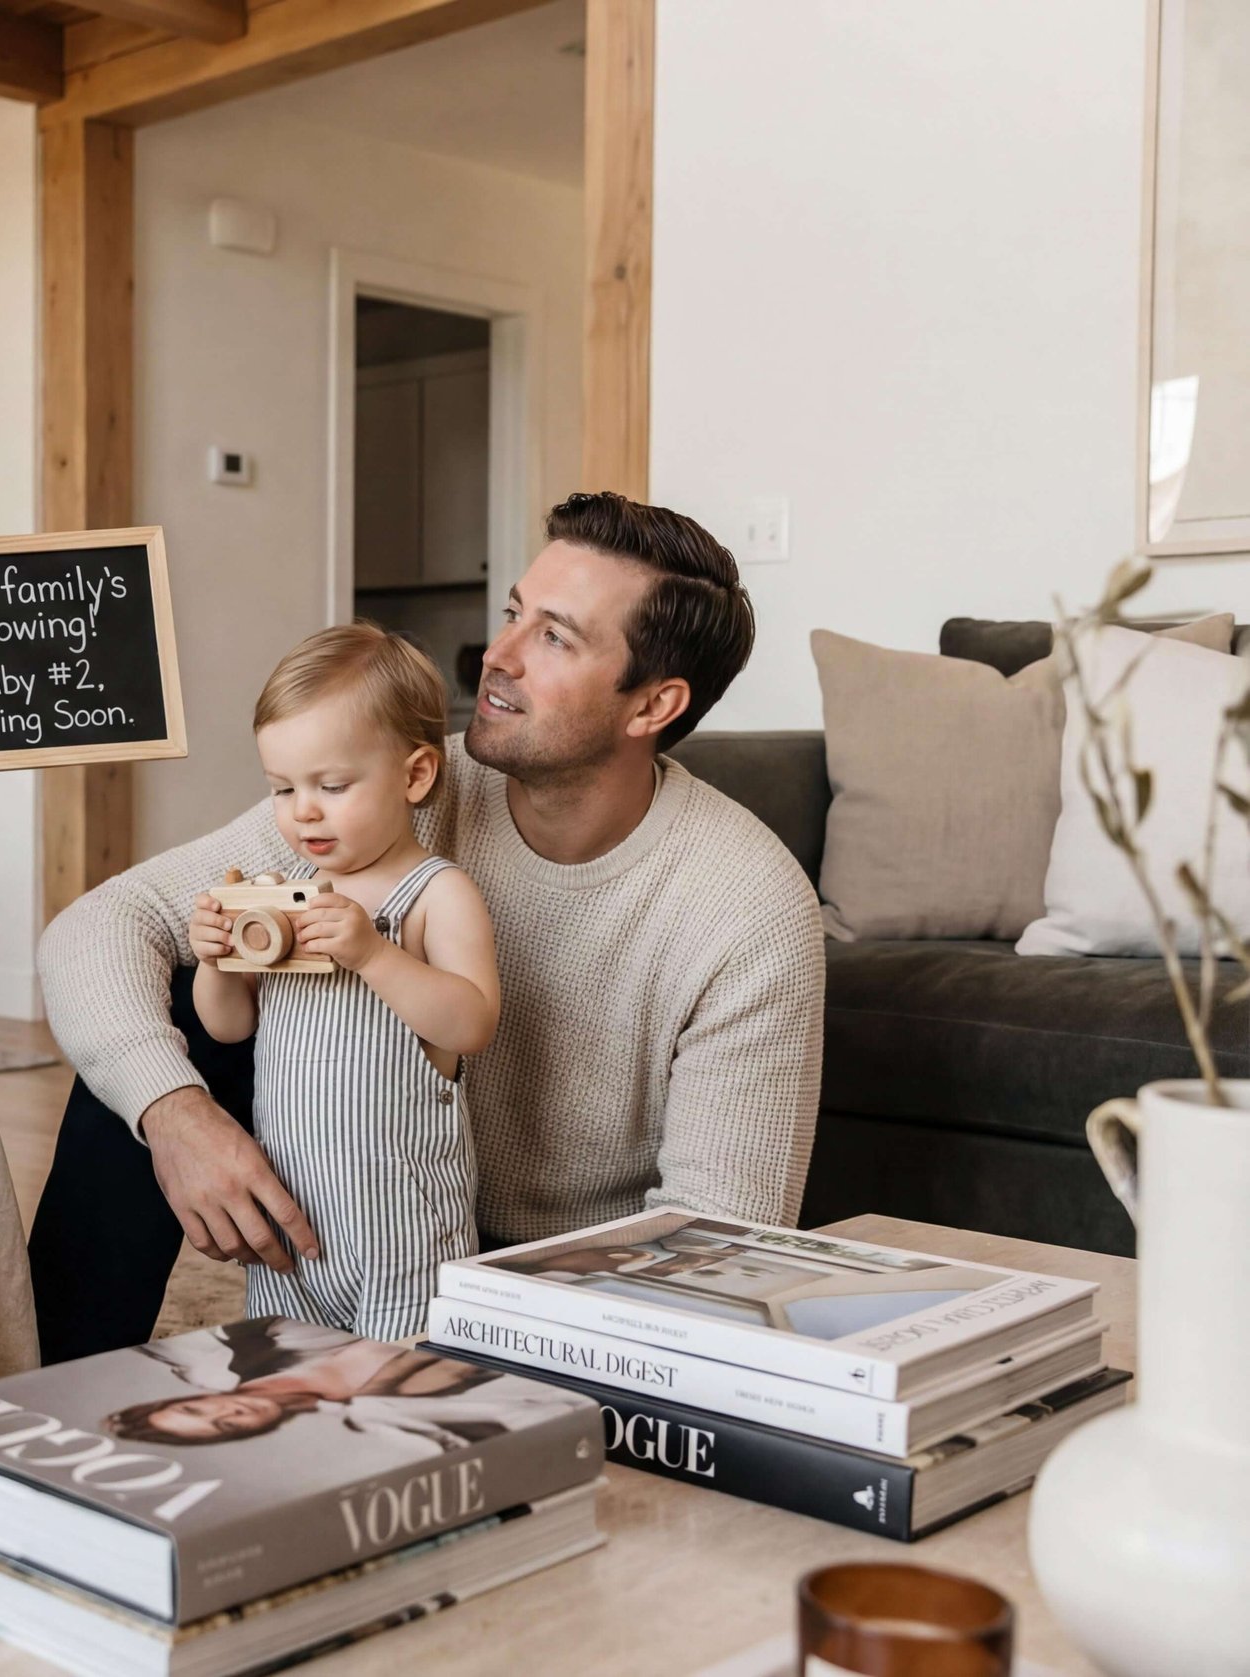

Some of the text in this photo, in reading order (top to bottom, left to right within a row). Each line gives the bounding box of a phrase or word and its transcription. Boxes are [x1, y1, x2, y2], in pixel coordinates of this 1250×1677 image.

[0, 565, 127, 616] family's
[53, 700, 135, 729] Soon.
[443, 1316, 601, 1371] ARCHITECTURAL
[606, 1352, 678, 1388] DIGEST
[600, 1404, 716, 1478] OGUE
[339, 1457, 485, 1552] VOGUE
